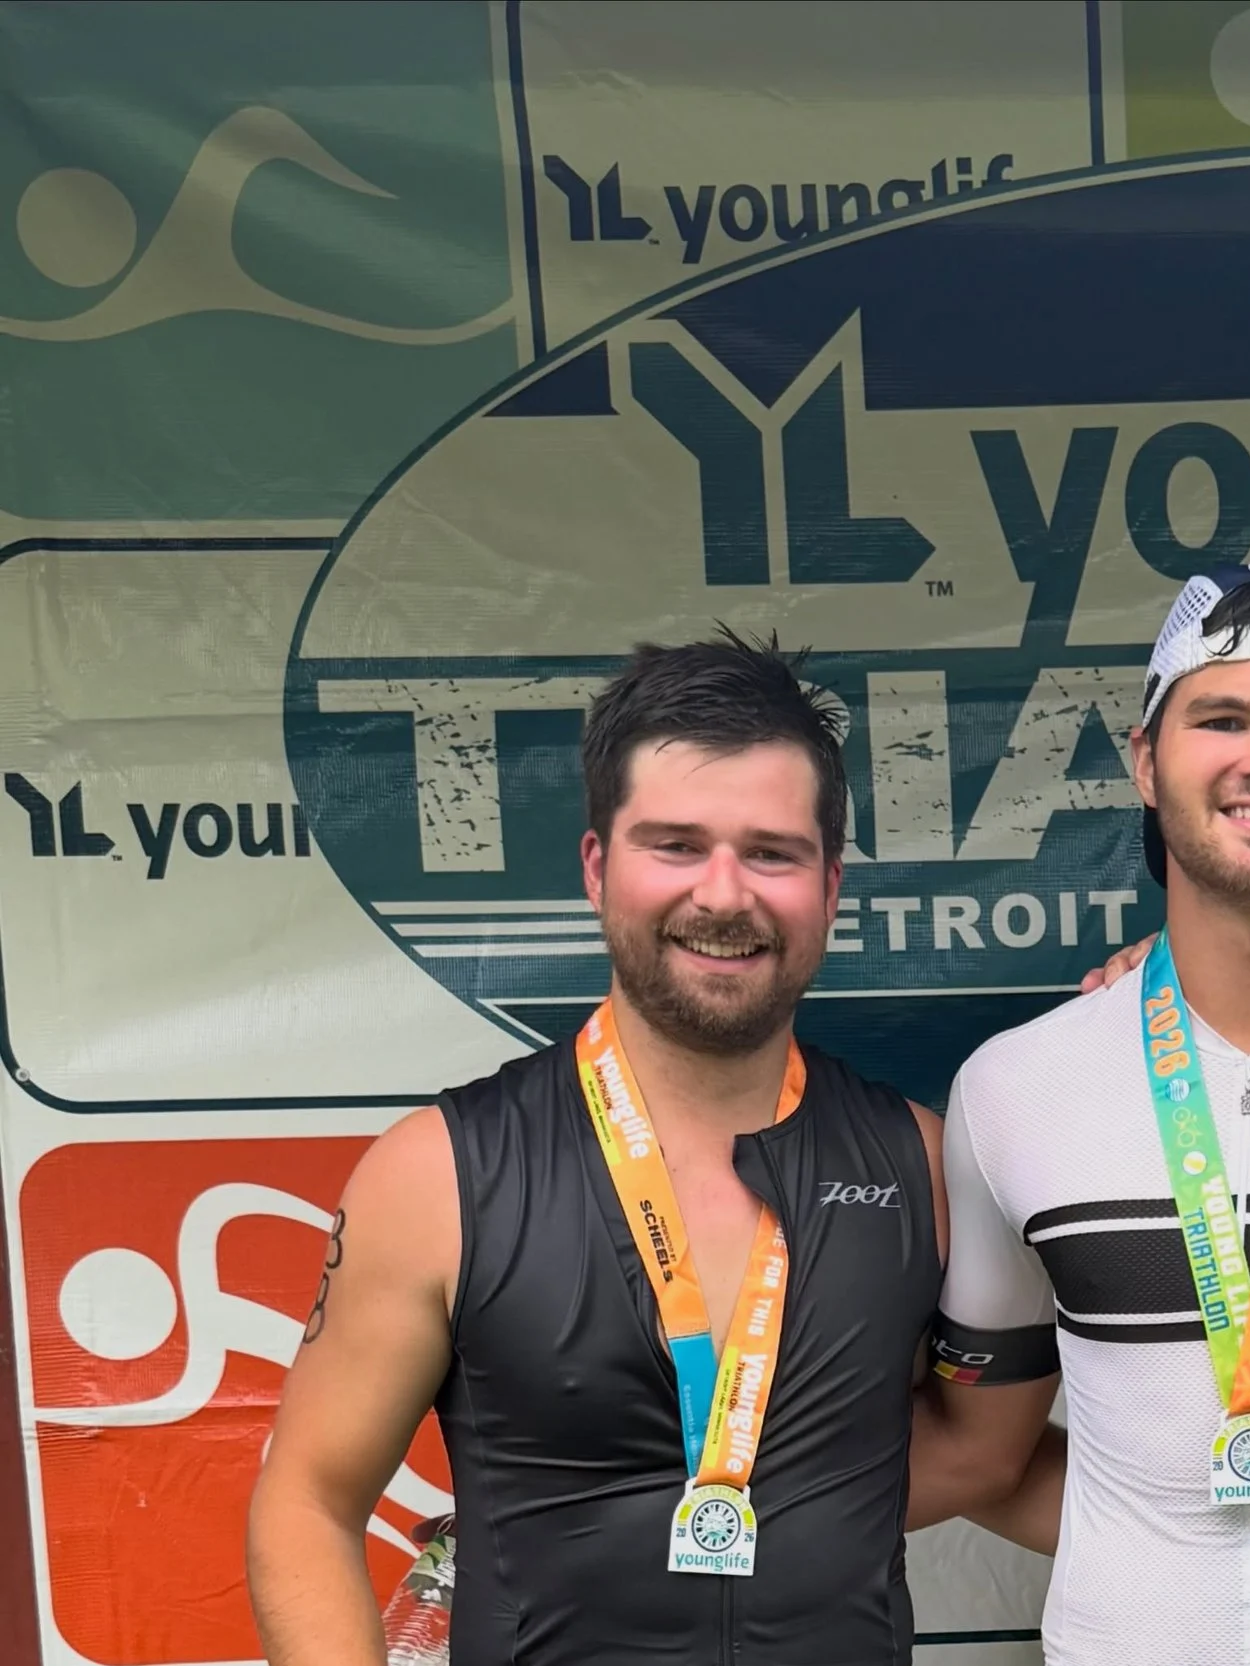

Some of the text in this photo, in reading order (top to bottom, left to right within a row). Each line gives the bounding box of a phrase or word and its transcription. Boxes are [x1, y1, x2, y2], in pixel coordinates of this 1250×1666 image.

[1146, 986, 1190, 1078] 2026
[640, 1199, 674, 1284] SCHEELS
[1184, 1207, 1230, 1332] TRIATHLON
[1202, 1174, 1244, 1278] YOUNG
[931, 1336, 995, 1365] to
[726, 1354, 768, 1474] younglife
[675, 1552, 750, 1572] younglife
